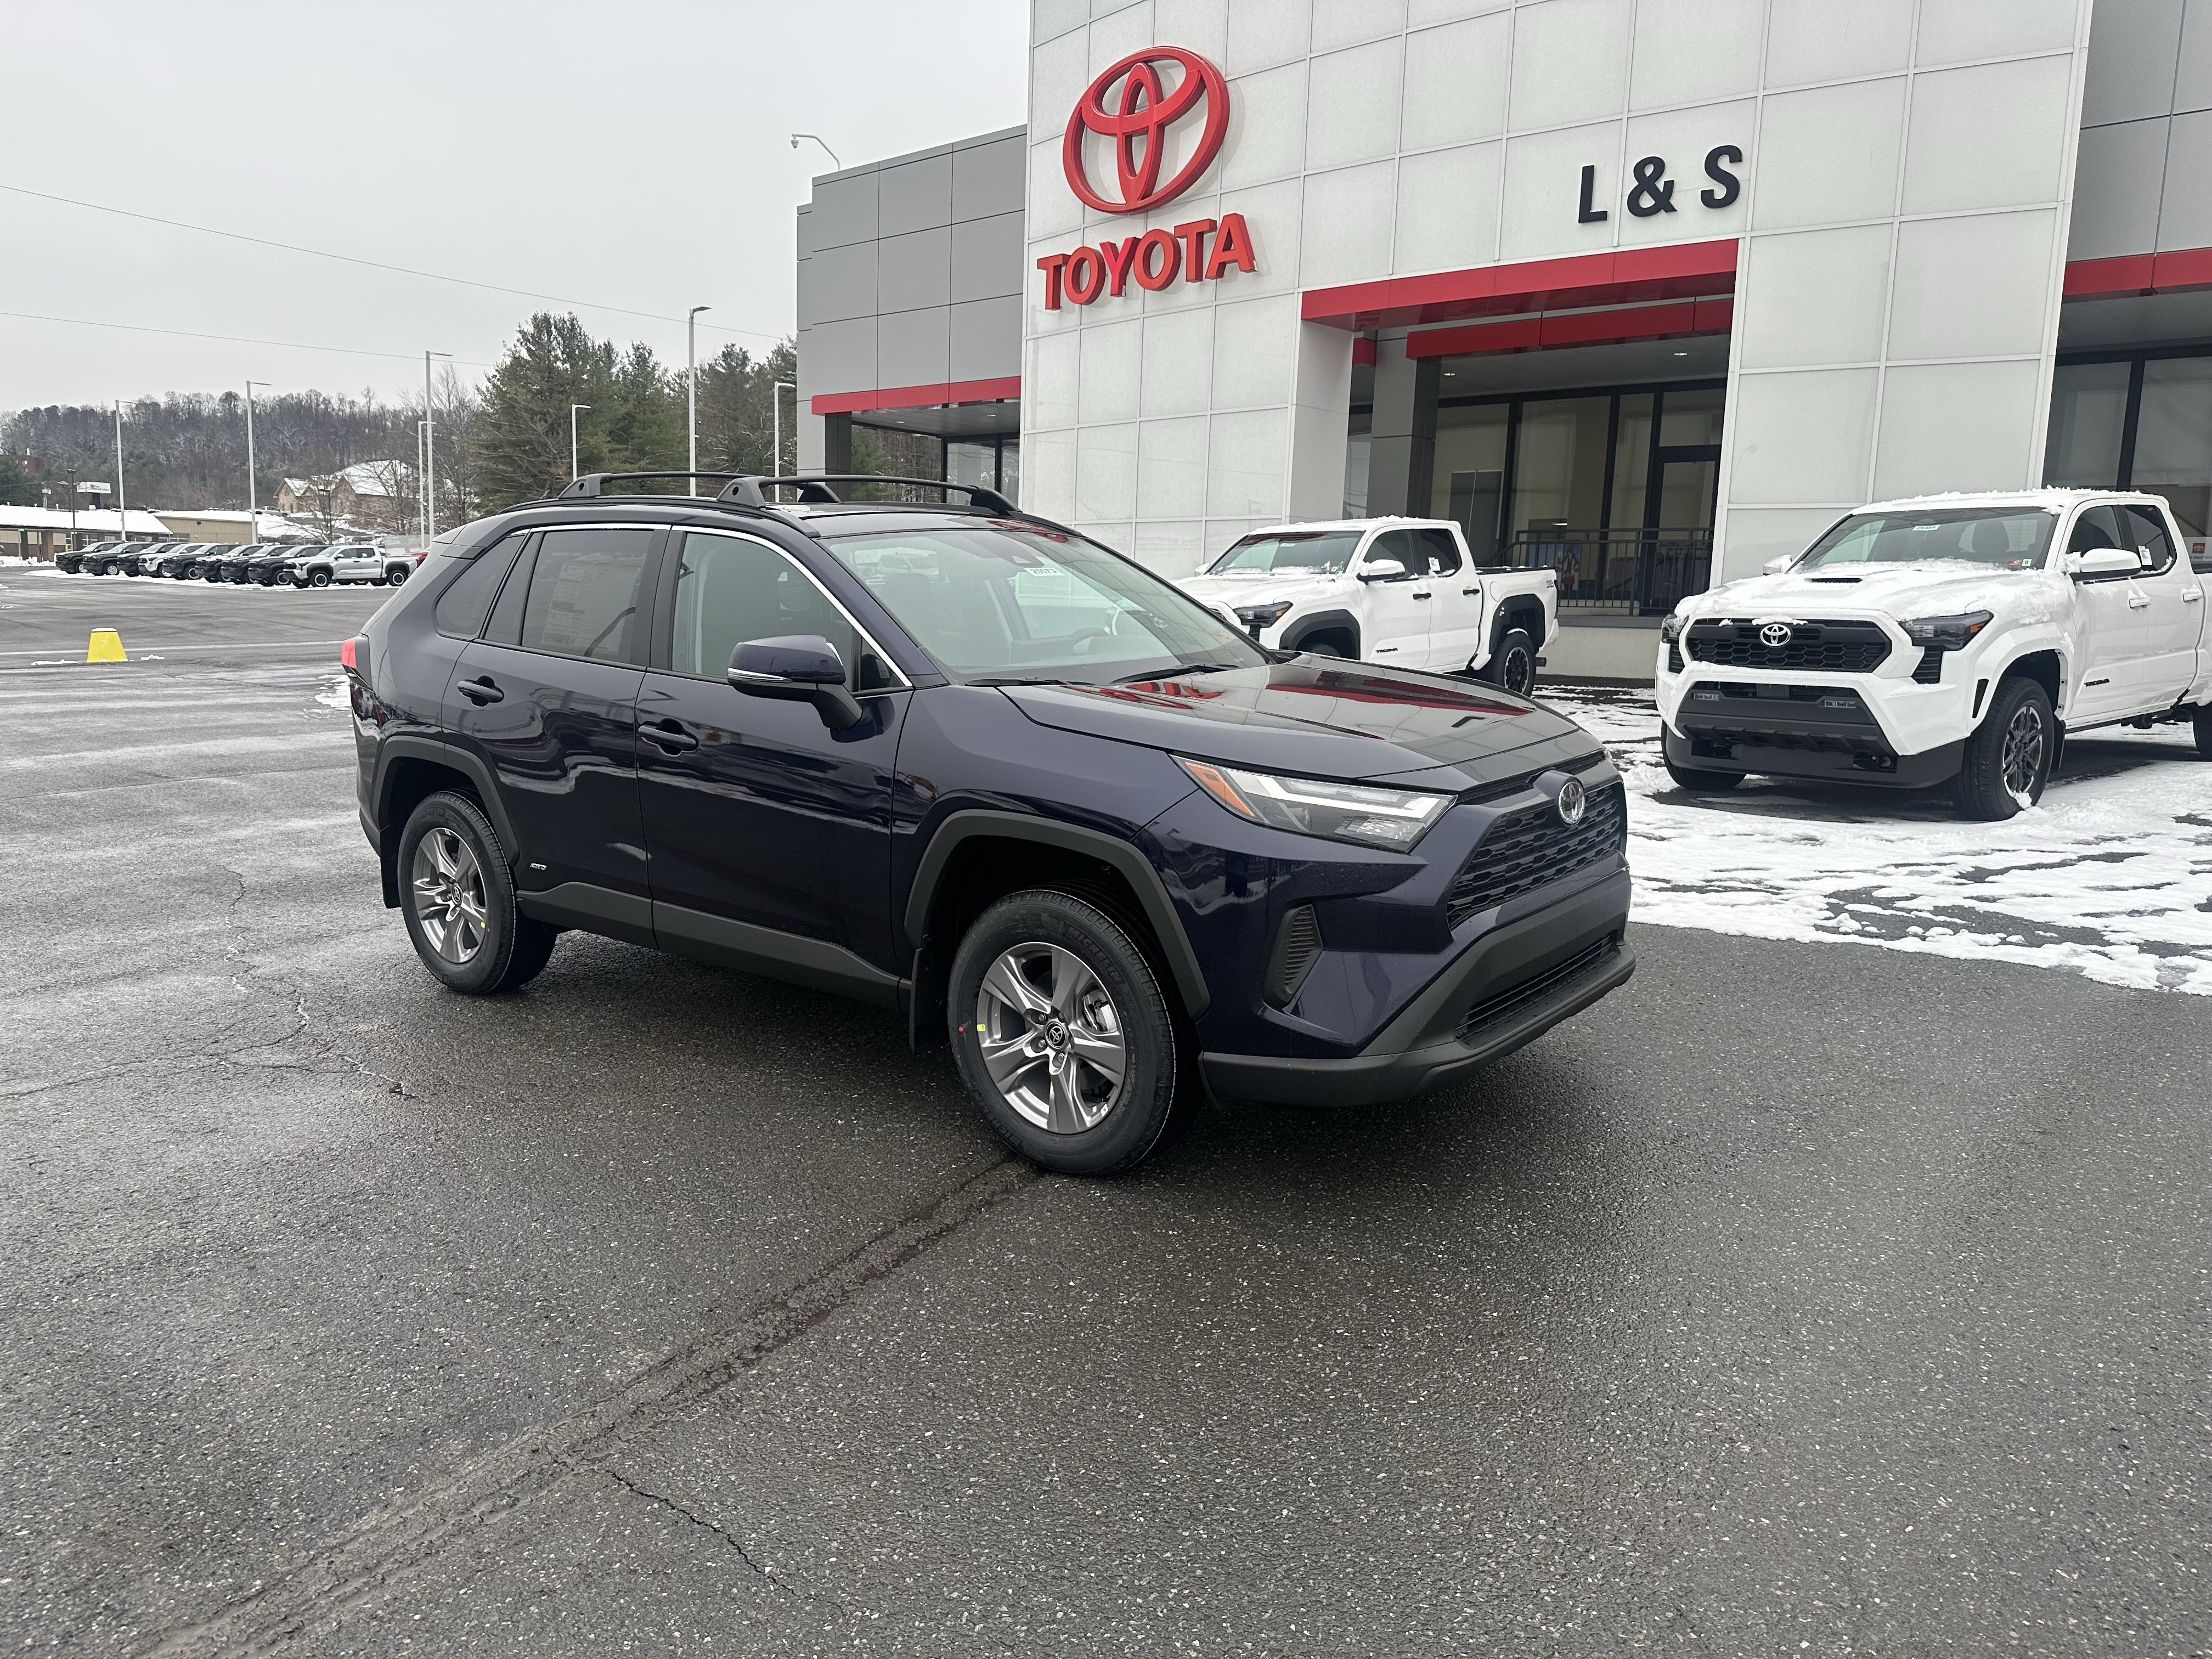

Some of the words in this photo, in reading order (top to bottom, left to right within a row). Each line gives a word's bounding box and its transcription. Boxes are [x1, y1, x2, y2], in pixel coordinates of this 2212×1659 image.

[1578, 165, 1608, 224] L
[1627, 156, 1678, 217] &
[1700, 144, 1743, 209] S
[1037, 213, 1259, 311] TOYOTA
[1068, 928, 1122, 984] MICHELIN
